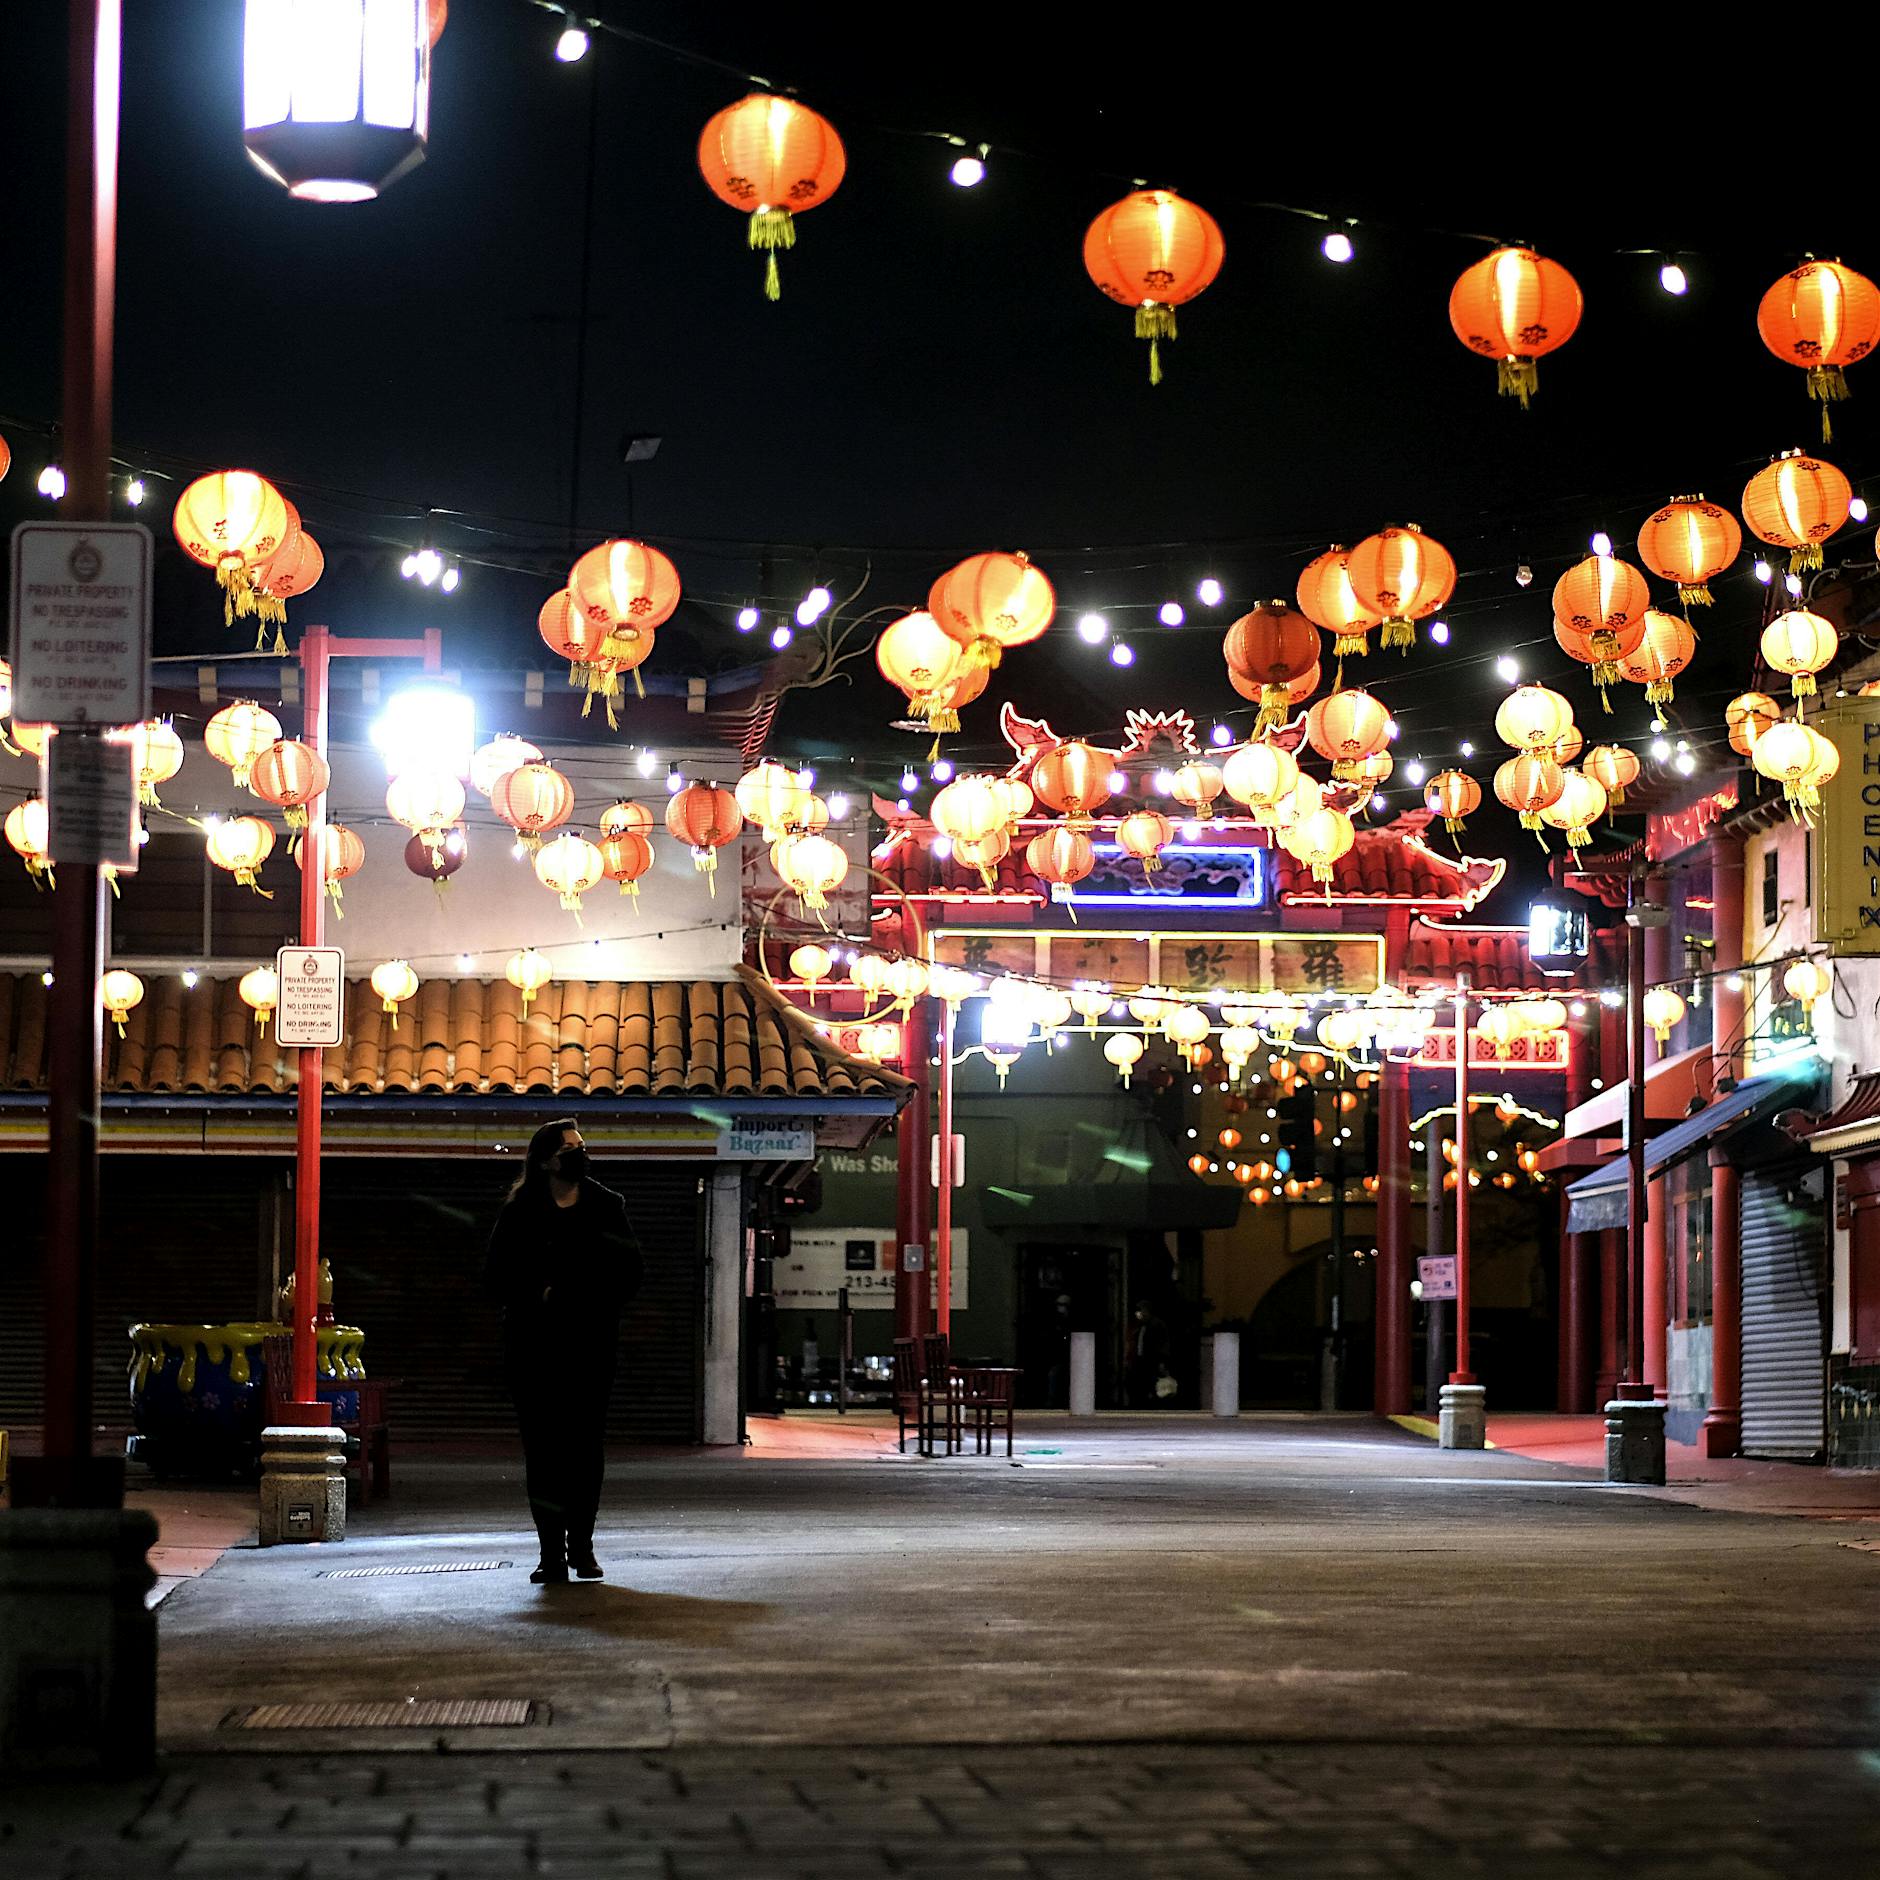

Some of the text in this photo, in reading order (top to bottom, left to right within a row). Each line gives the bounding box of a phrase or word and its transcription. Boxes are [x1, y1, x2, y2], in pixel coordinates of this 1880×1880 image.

[33, 605, 130, 618] NO TRESPASSING
[32, 640, 129, 653] NO LOITERING
[31, 676, 128, 690] NO DRINKING
[285, 976, 335, 984] PRIVATE PROPERTY
[298, 1020, 332, 1028] DRINKING
[729, 1135, 801, 1154] Bazaar
[830, 1155, 866, 1172] Was
